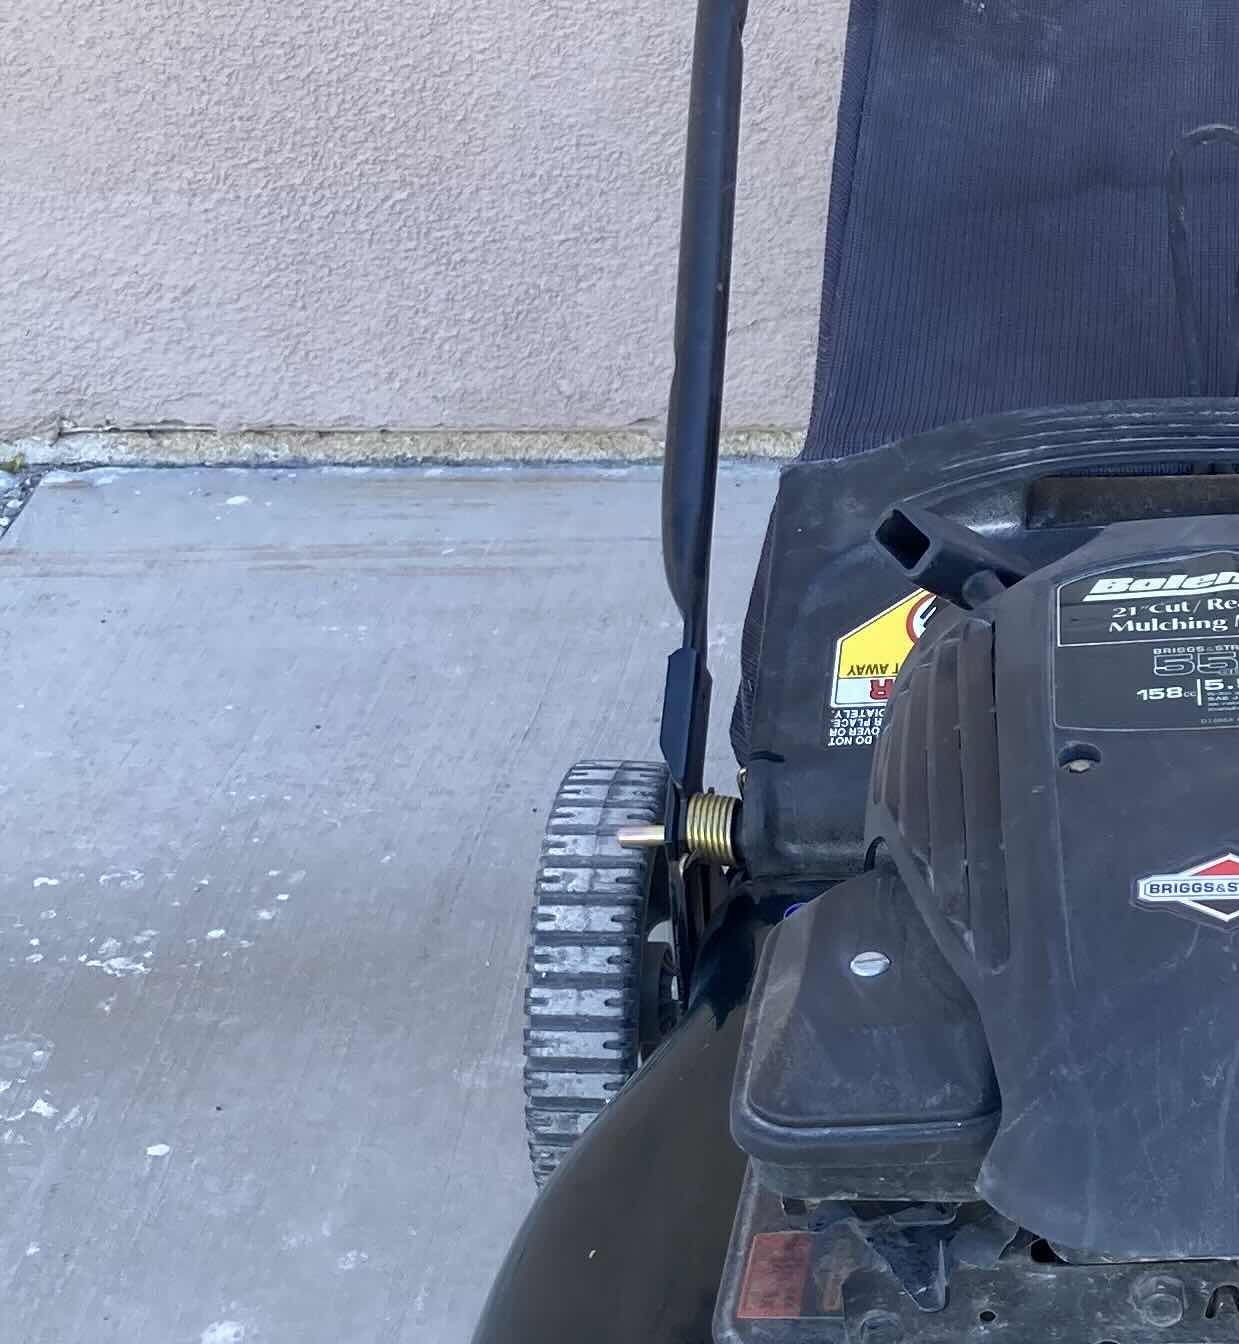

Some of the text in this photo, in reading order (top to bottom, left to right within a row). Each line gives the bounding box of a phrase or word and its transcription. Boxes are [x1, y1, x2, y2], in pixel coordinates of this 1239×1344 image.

[1109, 616, 1228, 632] Mulching
[846, 663, 889, 676] AWAY
[829, 727, 847, 737] OR
[827, 735, 873, 747] DO NOT
